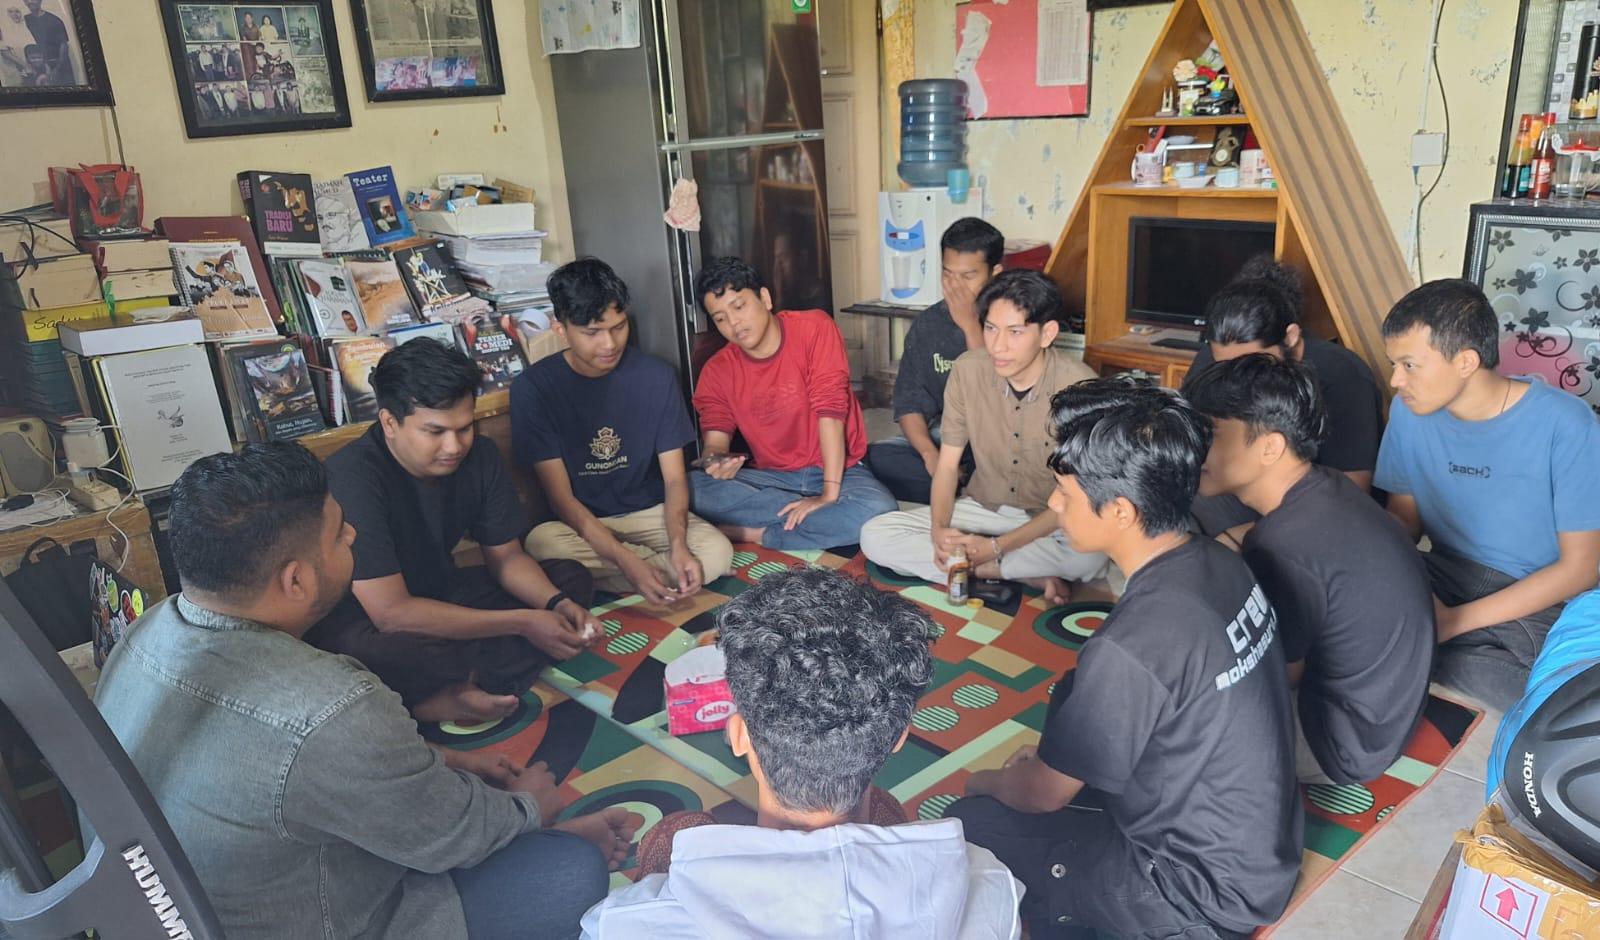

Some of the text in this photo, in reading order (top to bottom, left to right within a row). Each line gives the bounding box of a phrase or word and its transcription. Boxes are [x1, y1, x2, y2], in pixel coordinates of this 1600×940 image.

[352, 173, 389, 187] Teater
[264, 209, 292, 221] TRADISI
[266, 219, 293, 232] BARU
[1523, 751, 1543, 819] HONDA
[120, 845, 194, 940] HUMM
